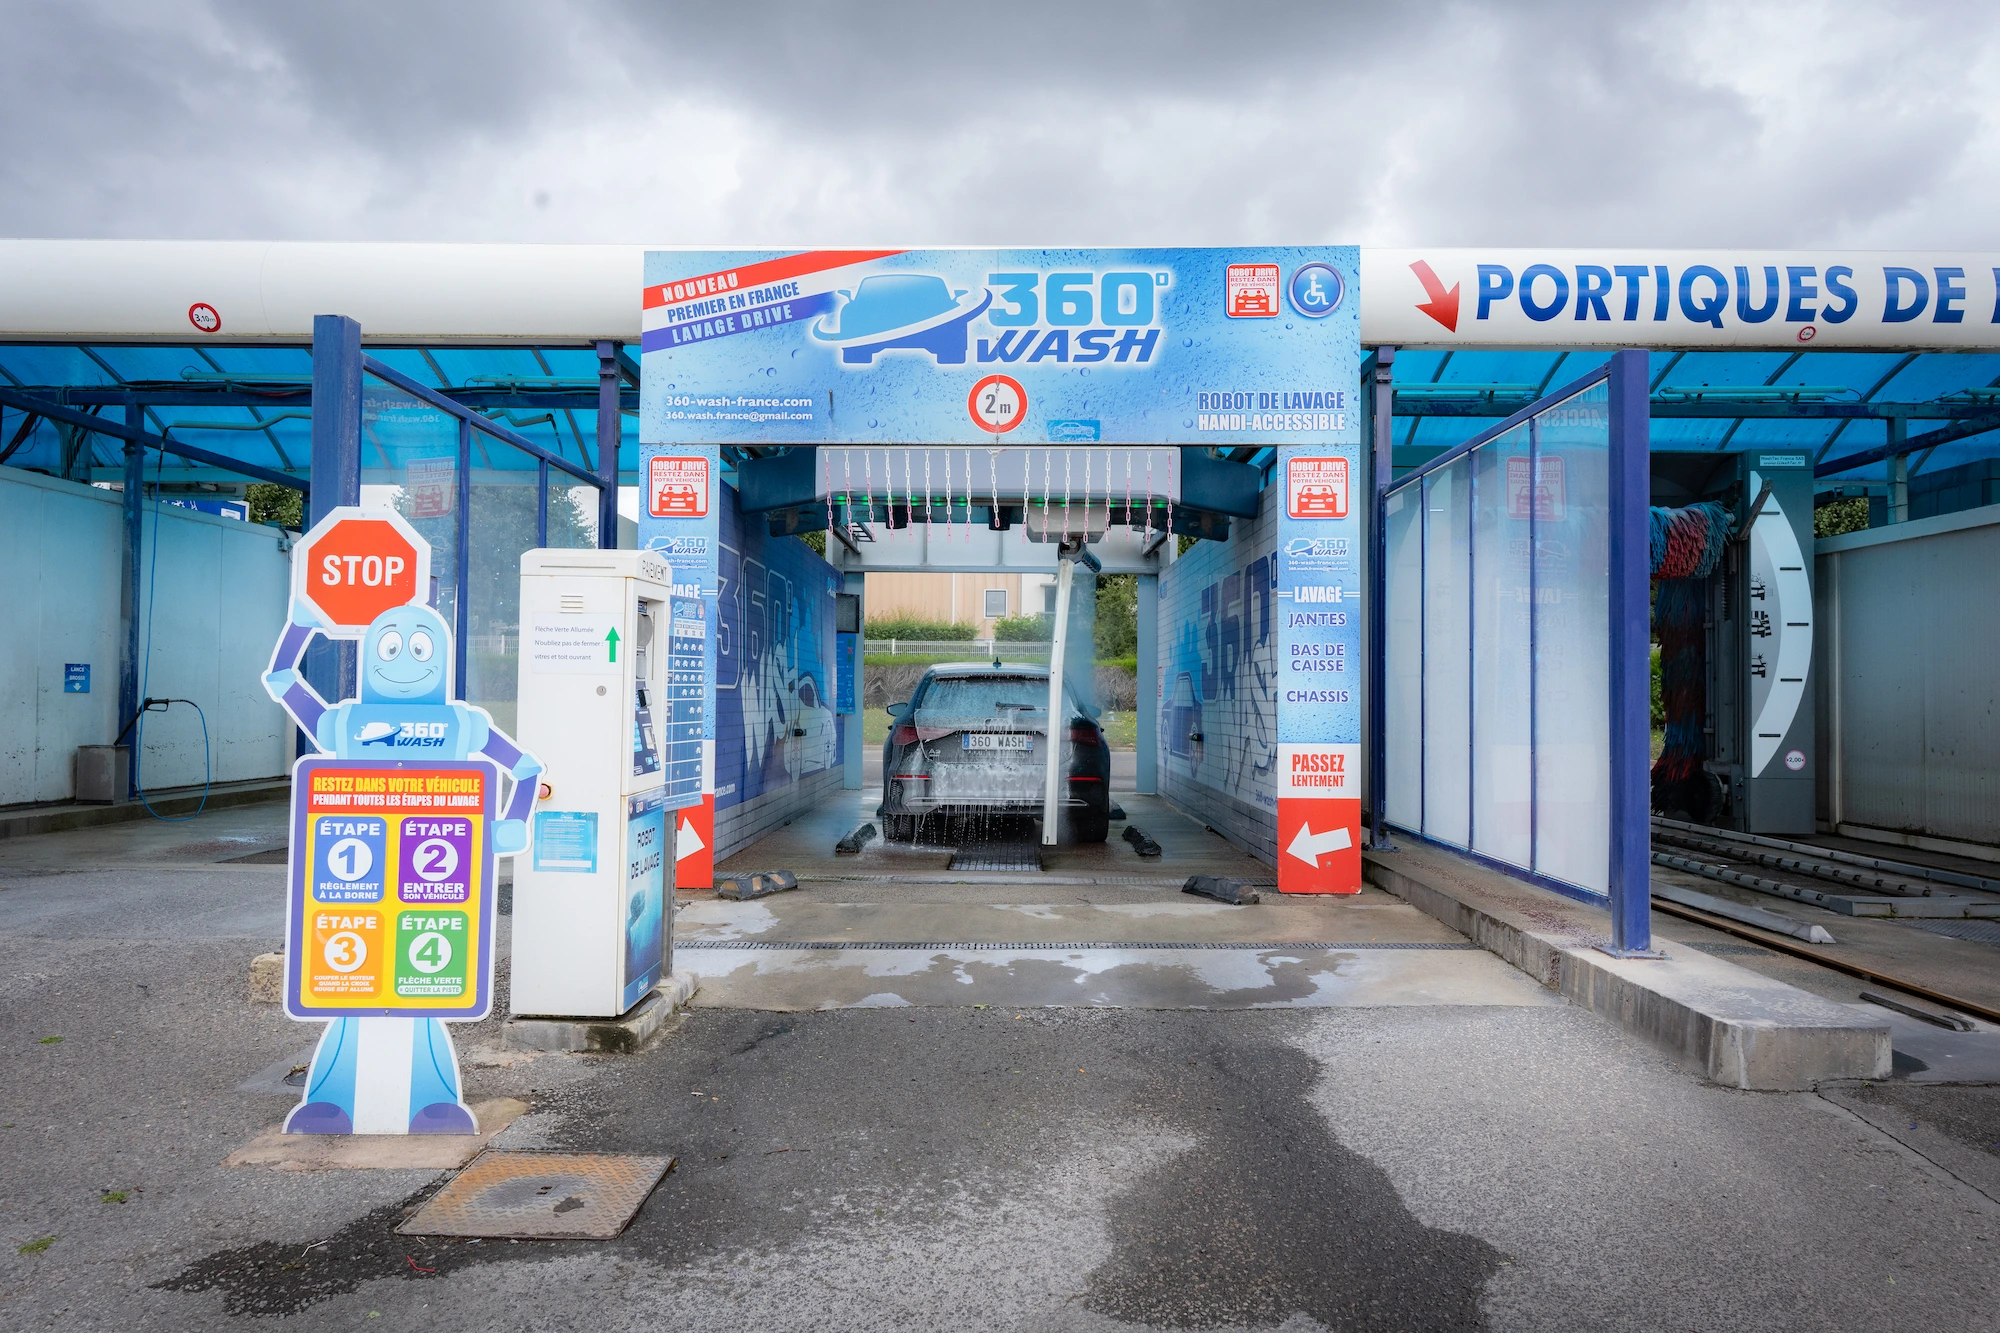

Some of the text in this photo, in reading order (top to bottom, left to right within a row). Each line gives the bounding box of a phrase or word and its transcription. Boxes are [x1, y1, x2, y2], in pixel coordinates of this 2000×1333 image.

[1230, 267, 1278, 276] ROBOT DRIVE
[661, 272, 739, 303] NOUVEAU
[667, 281, 800, 324] PREMIER EN FRANCE
[1476, 263, 1858, 329] PORTIQUES
[1881, 266, 1966, 323] DE
[672, 304, 793, 344] LAVAGE DRIVE
[977, 329, 1161, 363] WASH
[665, 395, 813, 408] 360-wash-france.com
[985, 393, 996, 414] 2
[1198, 391, 1345, 411] ROBOT DE LAVAGE
[665, 410, 813, 422] 360.wash.france@gmail.com
[1198, 413, 1346, 432] HANDI-ACCESSIBLE
[652, 460, 706, 471] ROBOT DRIVE
[1290, 461, 1346, 471] ROBOT DRIVE
[322, 554, 404, 586] STOP
[671, 583, 701, 599] VAGE
[1295, 586, 1343, 603] LAVAGE
[1288, 612, 1346, 629] JANTES
[1291, 643, 1344, 656] BAS DE
[1291, 659, 1344, 672] CAISSE
[1286, 689, 1349, 703] CHASSIS
[397, 738, 445, 747] WASH
[971, 736, 990, 747] 360
[998, 736, 1024, 747] WASH
[1291, 753, 1345, 773] PASSEZ
[313, 776, 480, 793] RESTEZ DANS VOTRE VÉHICULE
[1291, 774, 1345, 787] LENTEMENT
[313, 793, 480, 807] PENDANT TOUTES LES ÉTAPES DU LAVAGE
[320, 820, 381, 836] ÉTAPE
[405, 820, 466, 837] ÉTAPE
[637, 827, 656, 849] ROBOT
[338, 845, 356, 875] 1
[422, 844, 447, 874] 2
[631, 851, 660, 880] DE LAVAGE
[320, 881, 379, 891] RÈGLEMENT
[403, 883, 464, 894] ENTRER
[319, 890, 378, 900] À LA BORNE
[422, 892, 464, 900] VÉHICULE
[316, 914, 377, 930] ÉTAPE
[401, 915, 462, 931] ÉTAPE
[333, 936, 358, 966] 3
[415, 937, 442, 966] 4
[398, 976, 462, 985] FLÈCHE VERTE
